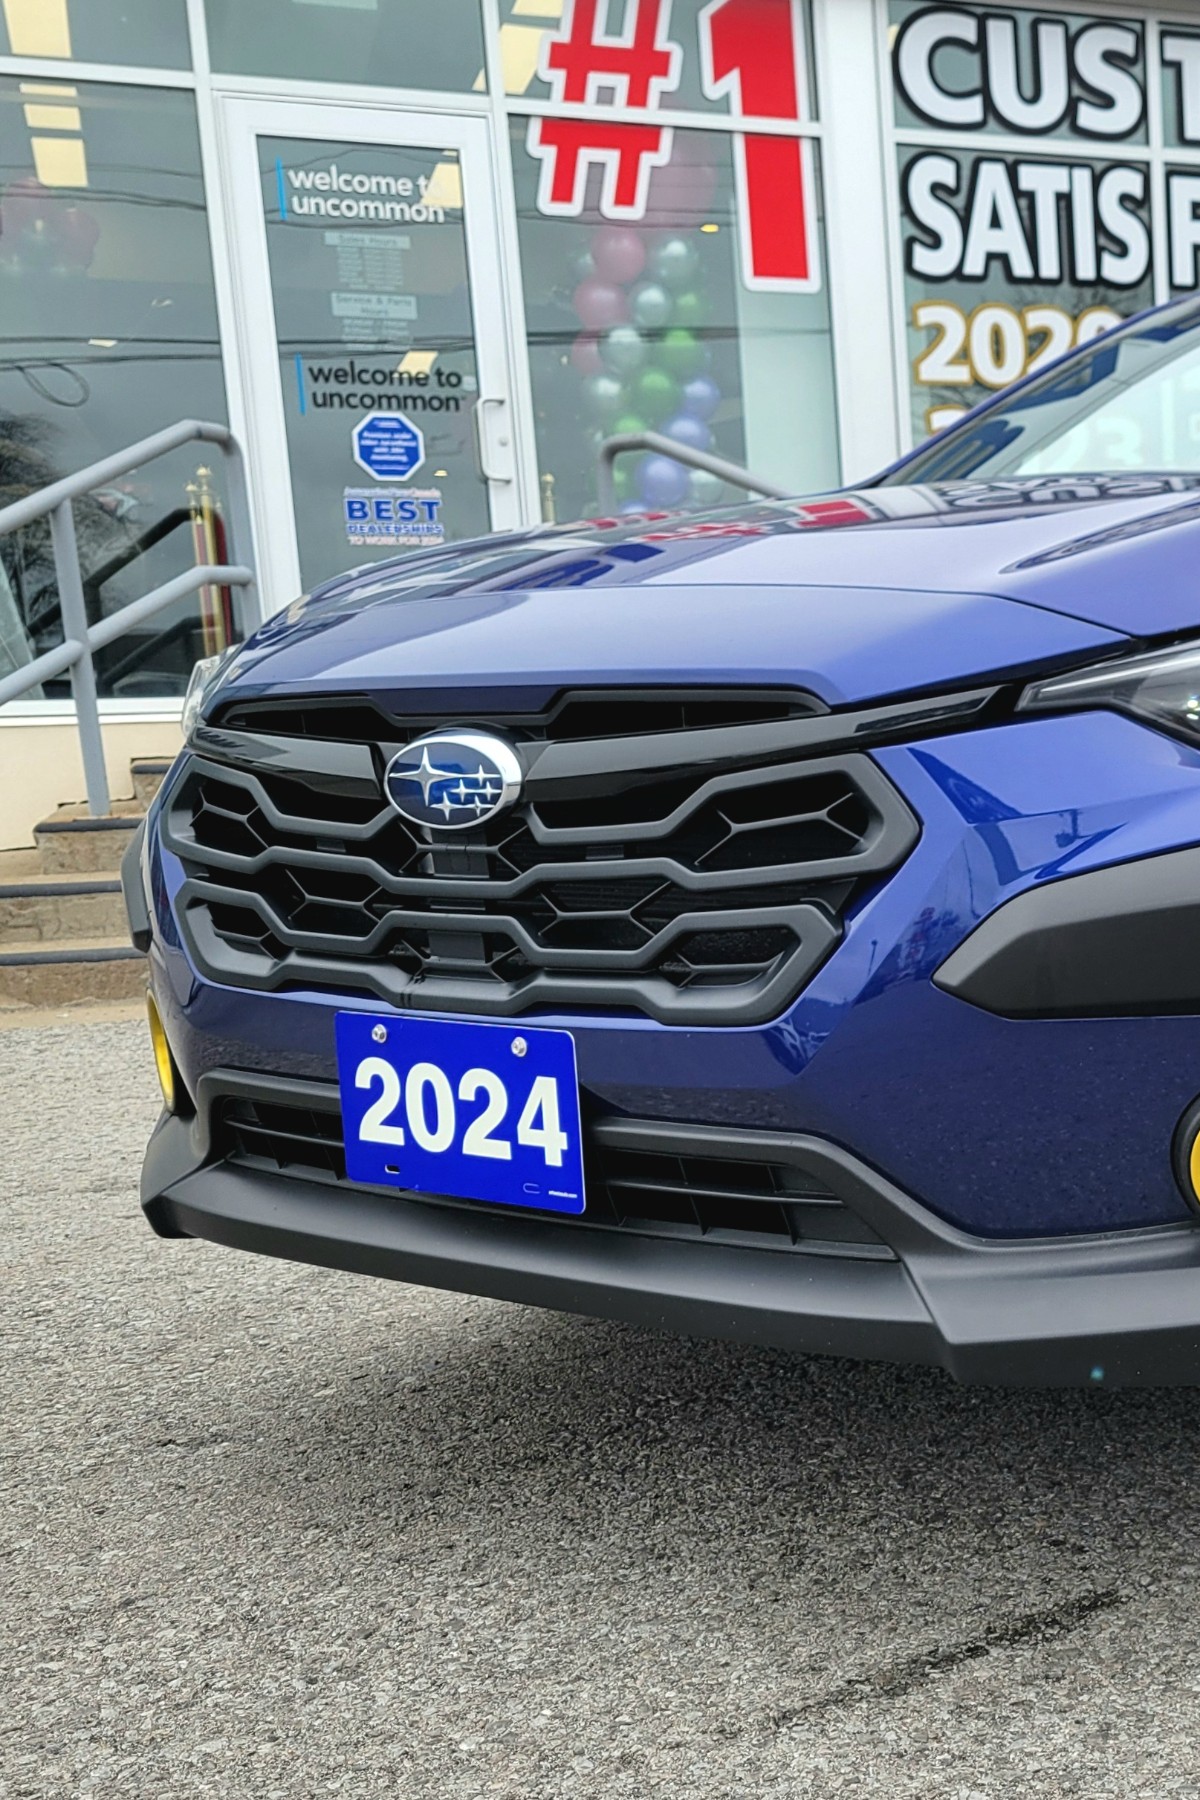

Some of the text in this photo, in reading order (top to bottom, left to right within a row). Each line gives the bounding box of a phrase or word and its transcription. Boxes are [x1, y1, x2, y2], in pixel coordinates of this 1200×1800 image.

[527, 0, 820, 293] #1
[287, 163, 413, 196] welcome
[292, 195, 445, 223] uncommon
[308, 360, 462, 388] welcome to
[312, 391, 461, 412] uncommon
[345, 498, 441, 521] BEST
[355, 1056, 569, 1168] 2024
